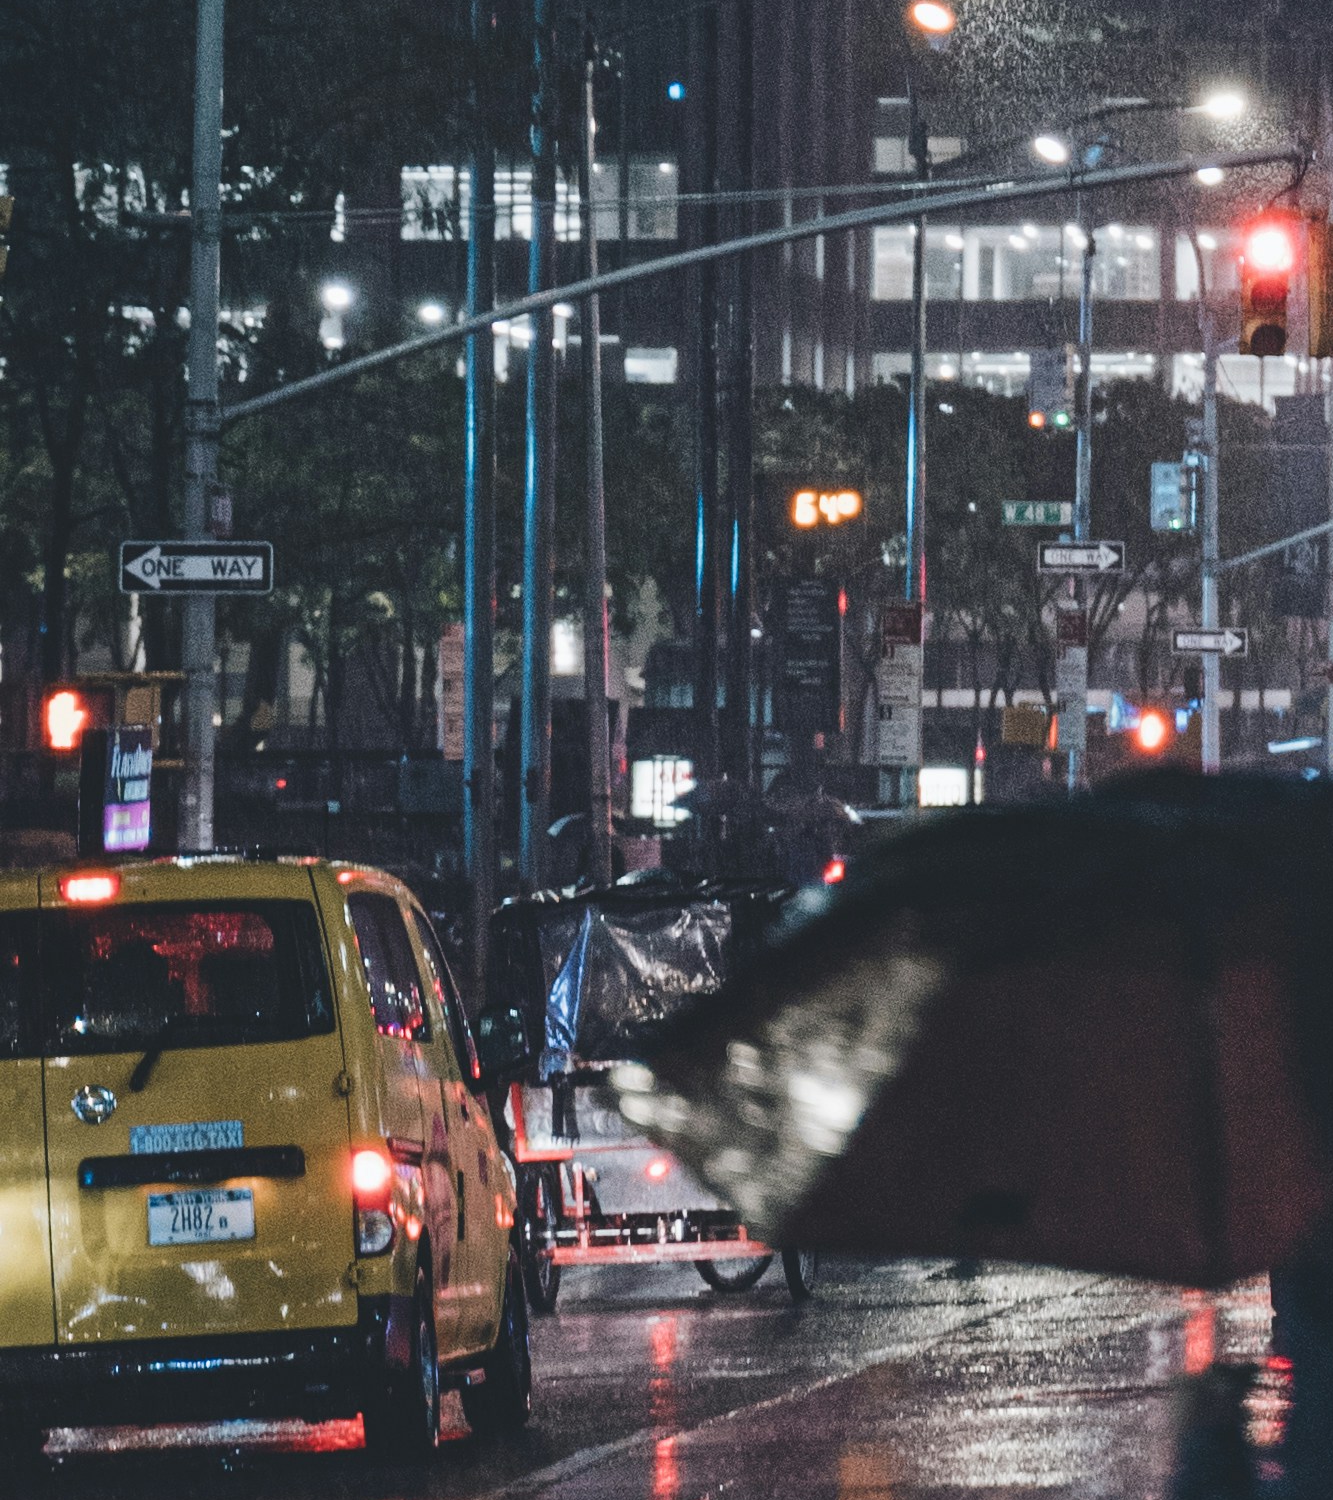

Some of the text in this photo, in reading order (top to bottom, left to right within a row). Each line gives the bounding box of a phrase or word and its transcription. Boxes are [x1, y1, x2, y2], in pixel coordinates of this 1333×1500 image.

[1085, 550, 1111, 561] WAY
[141, 557, 257, 578] ONE WAY
